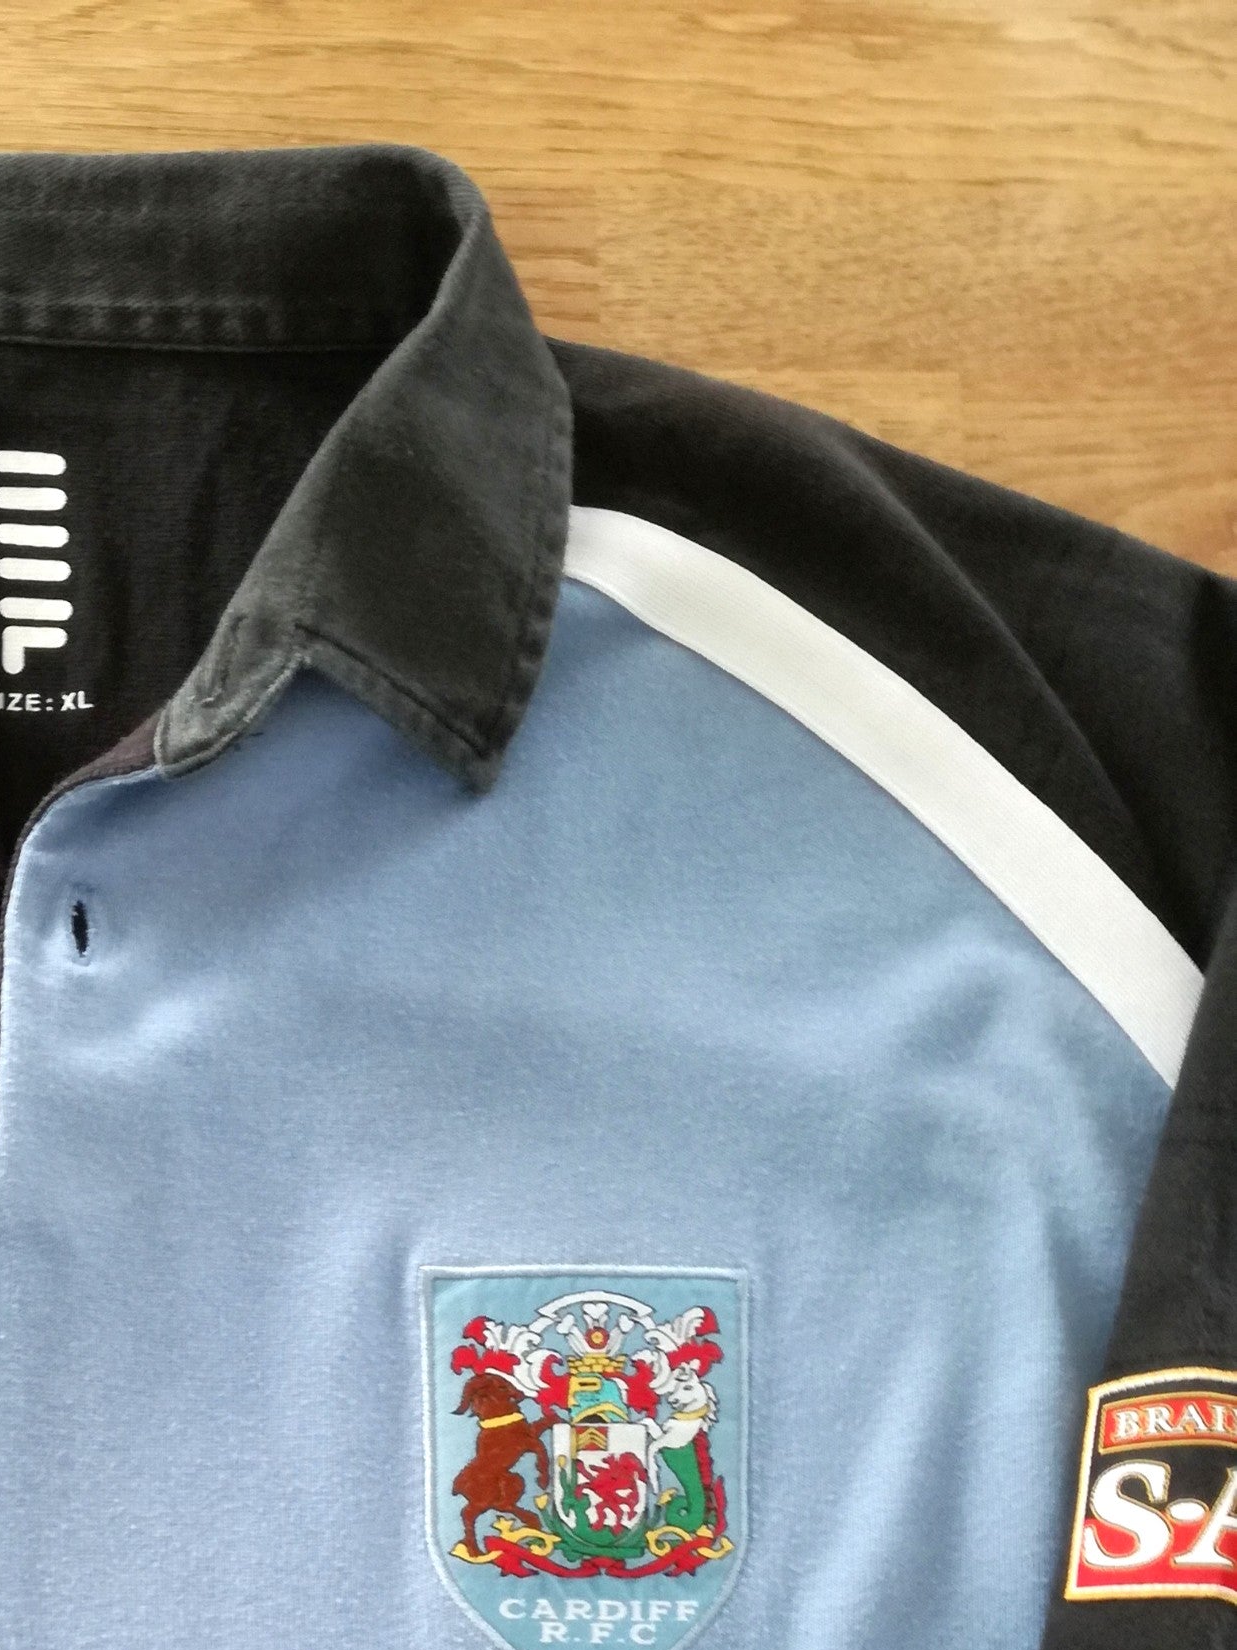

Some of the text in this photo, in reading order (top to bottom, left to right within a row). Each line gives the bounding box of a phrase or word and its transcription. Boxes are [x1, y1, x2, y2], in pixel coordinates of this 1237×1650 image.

[60, 690, 95, 712] XL
[1114, 1402, 1237, 1441] BRAI
[498, 1598, 700, 1623] CARDIFF
